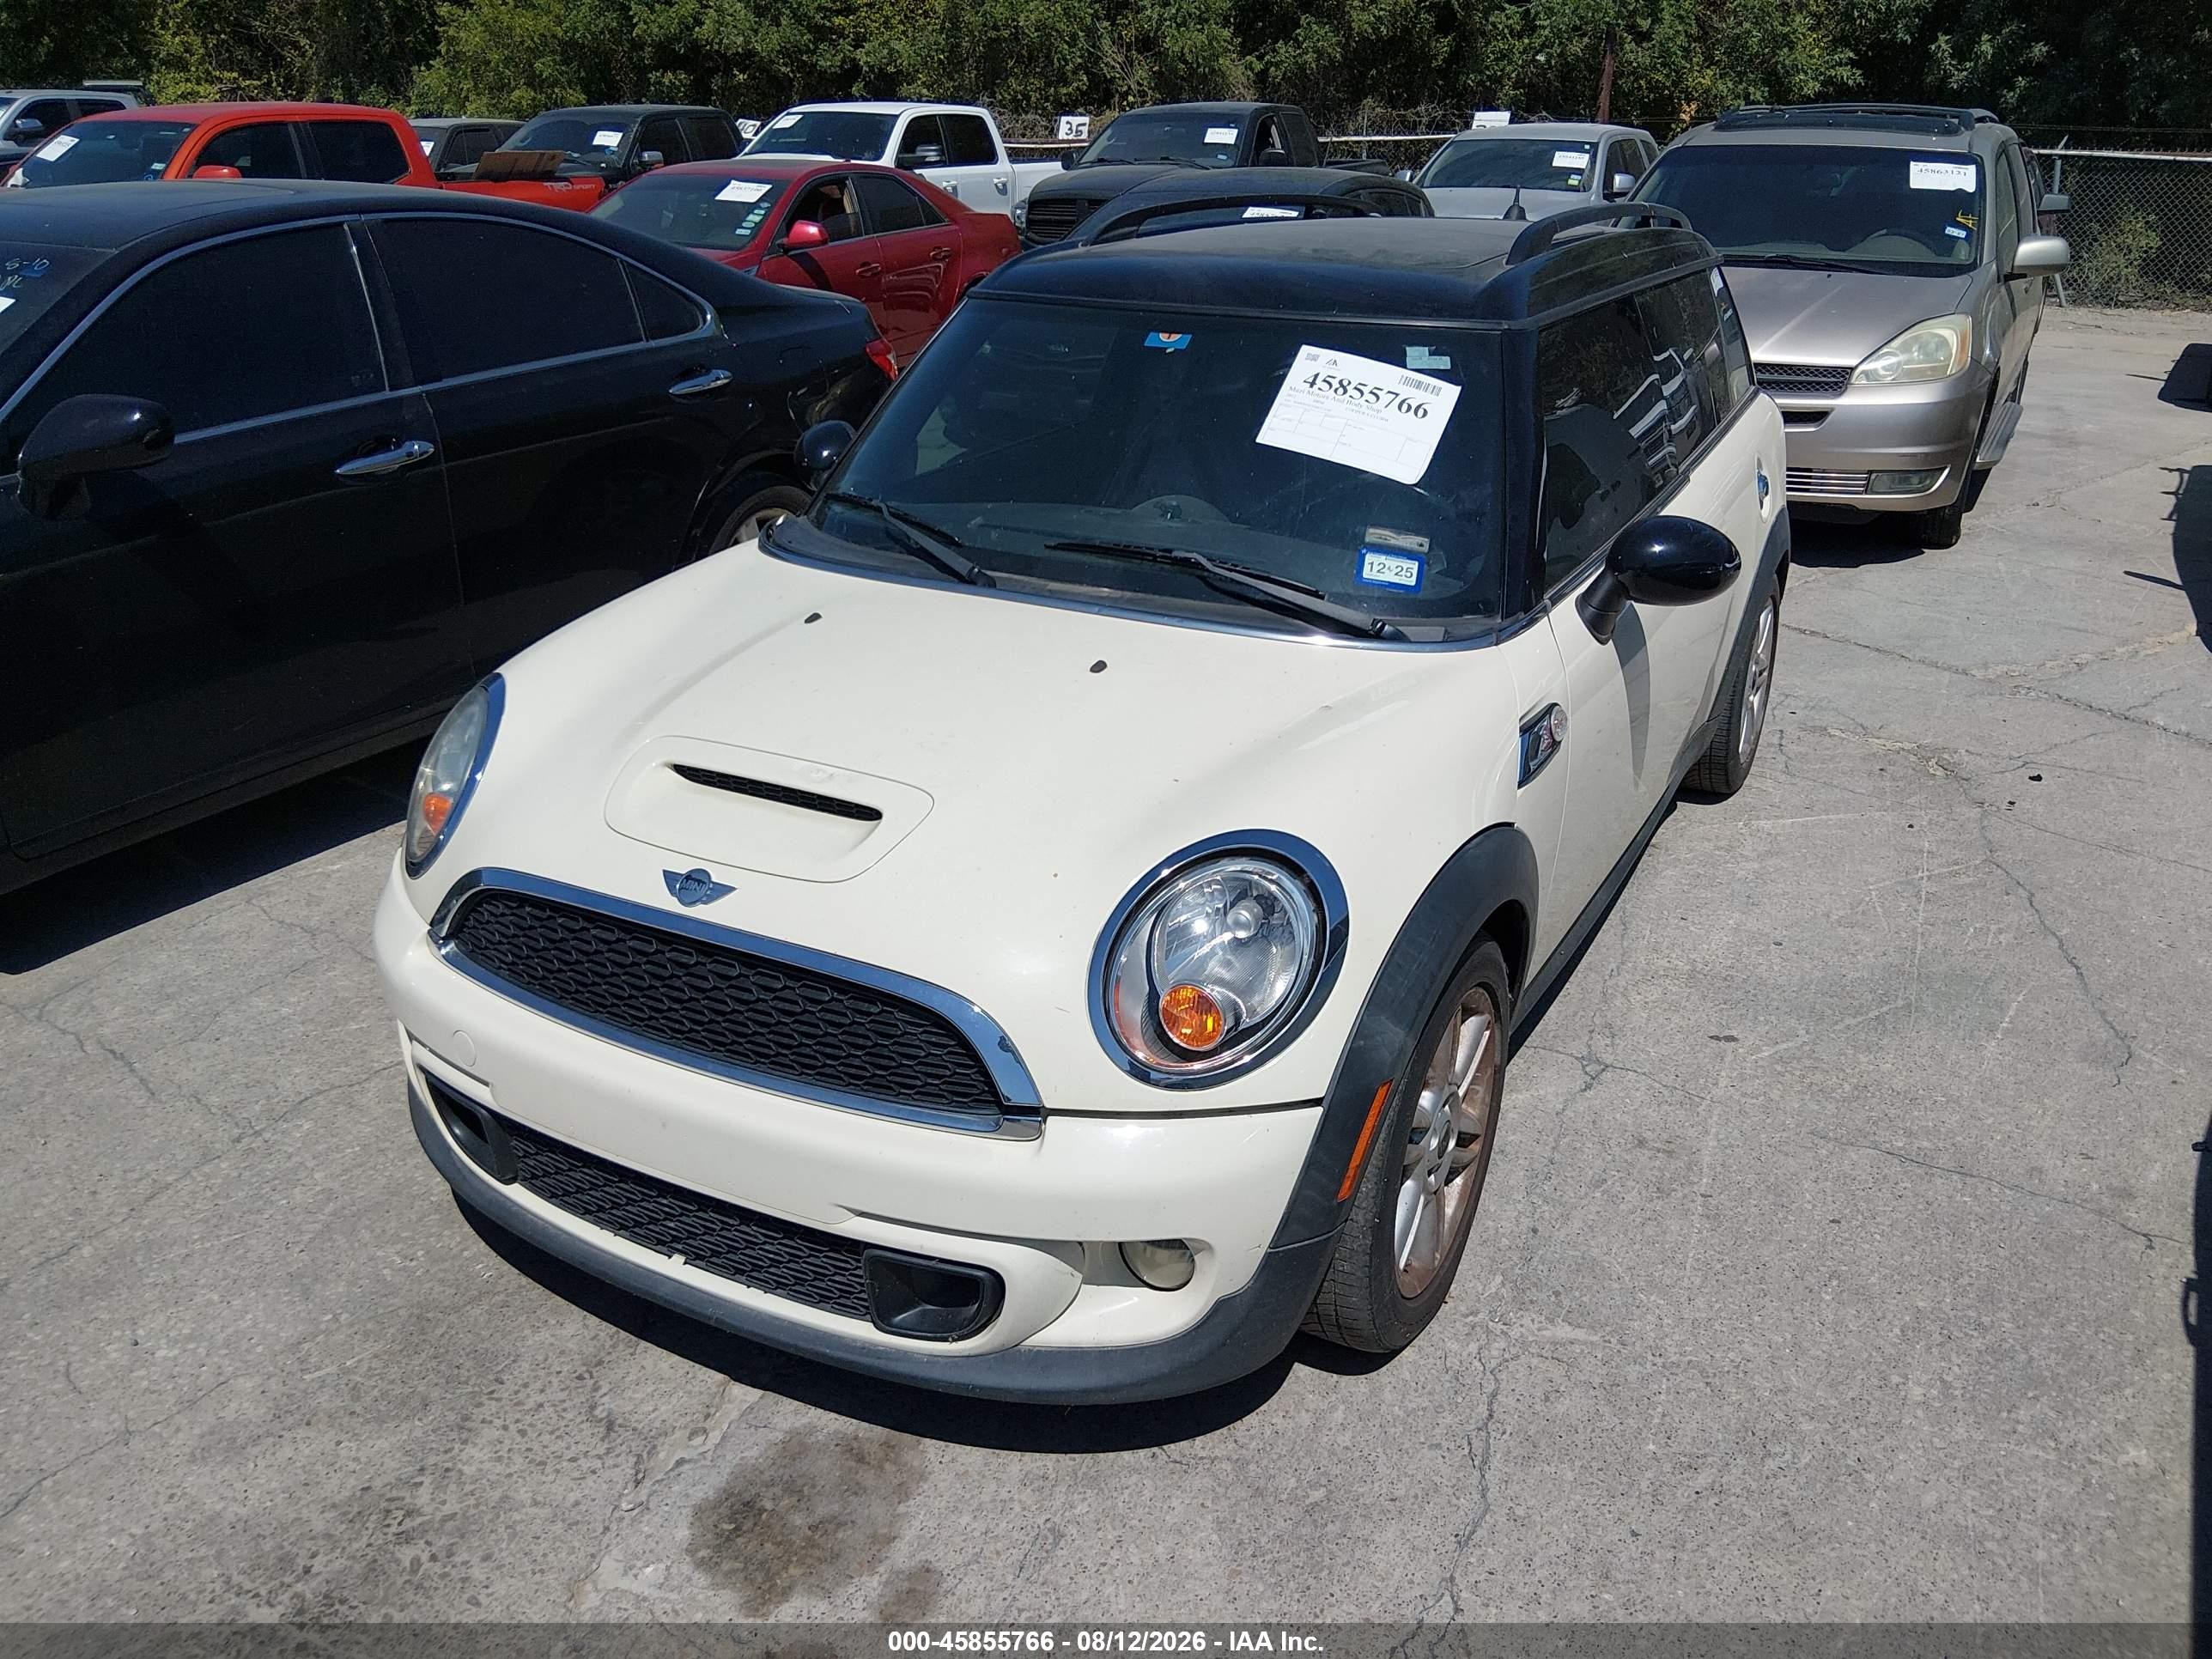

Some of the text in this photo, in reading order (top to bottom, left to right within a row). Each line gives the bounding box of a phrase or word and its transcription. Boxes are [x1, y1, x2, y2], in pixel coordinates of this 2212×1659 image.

[1065, 120, 1087, 137] 35
[1303, 372, 1432, 420] 45855766
[680, 878, 708, 894] MINI
